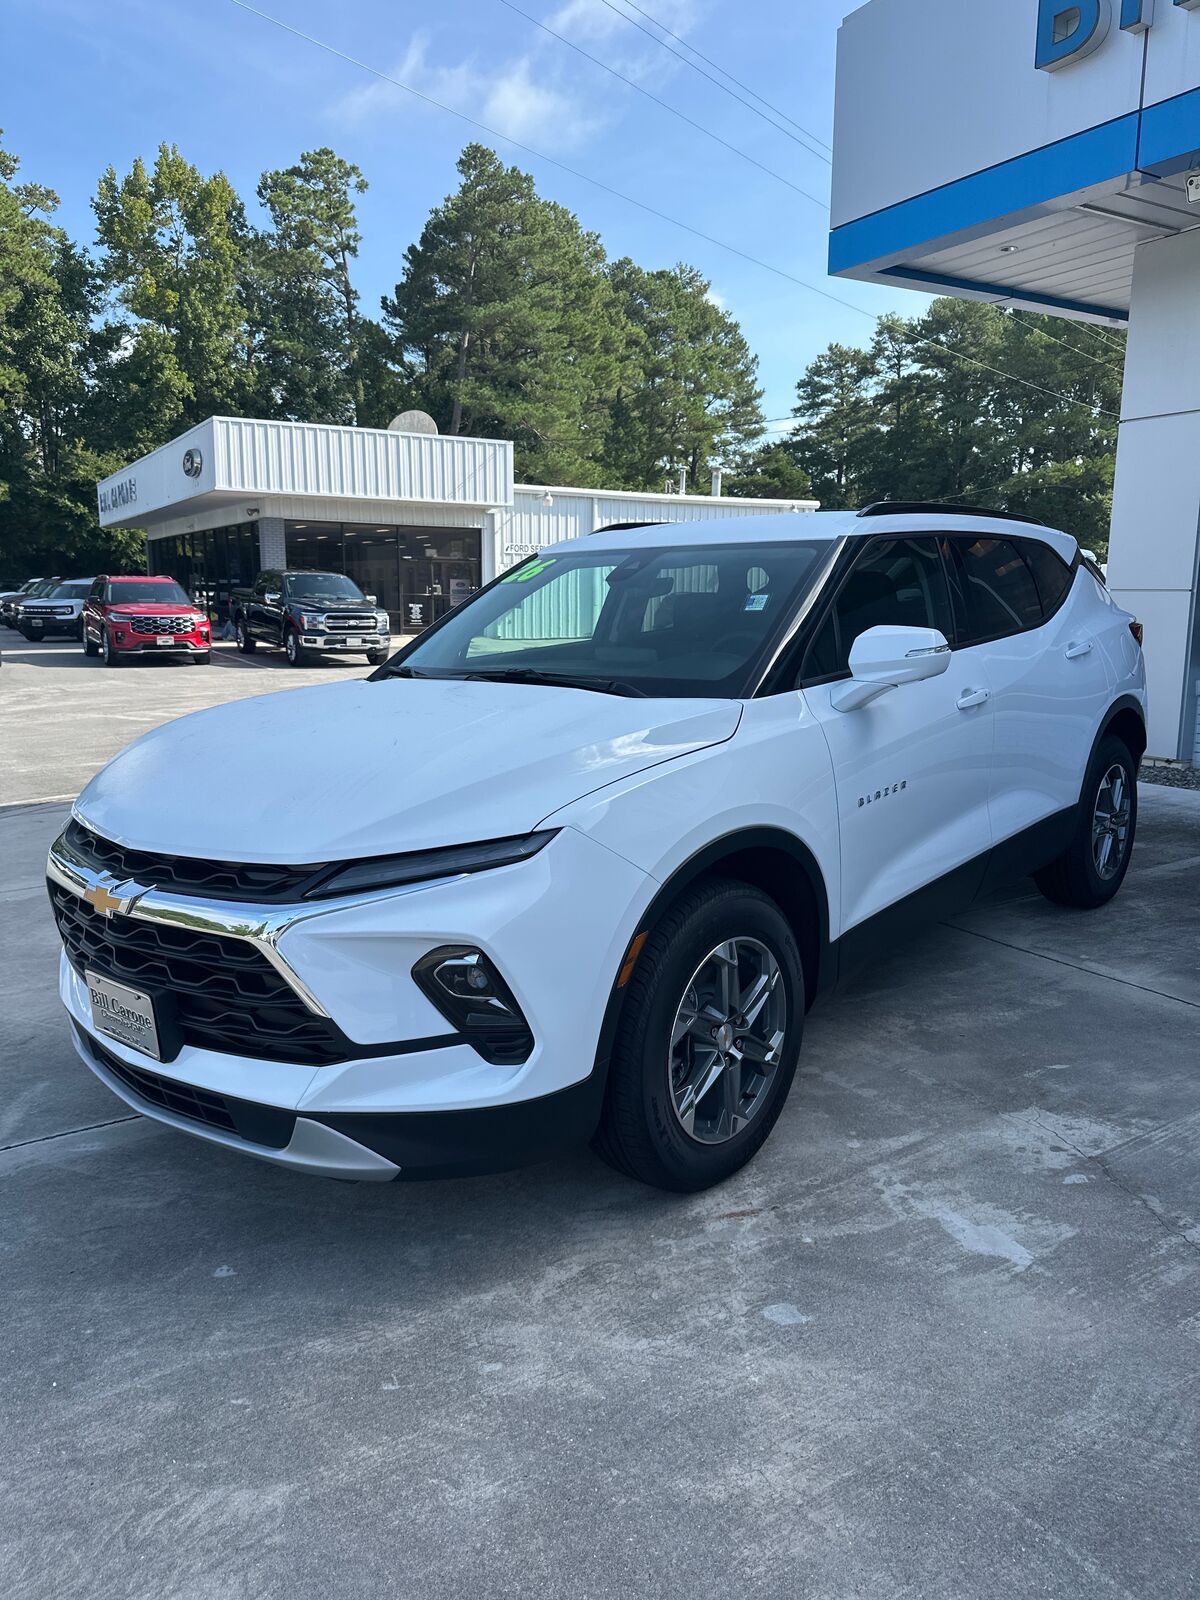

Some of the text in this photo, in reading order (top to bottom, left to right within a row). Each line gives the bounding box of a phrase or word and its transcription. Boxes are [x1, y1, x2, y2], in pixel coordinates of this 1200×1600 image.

[510, 544, 546, 553] FORD SER
[857, 780, 907, 808] BLAZER
[90, 987, 152, 1029] Bill Carone
